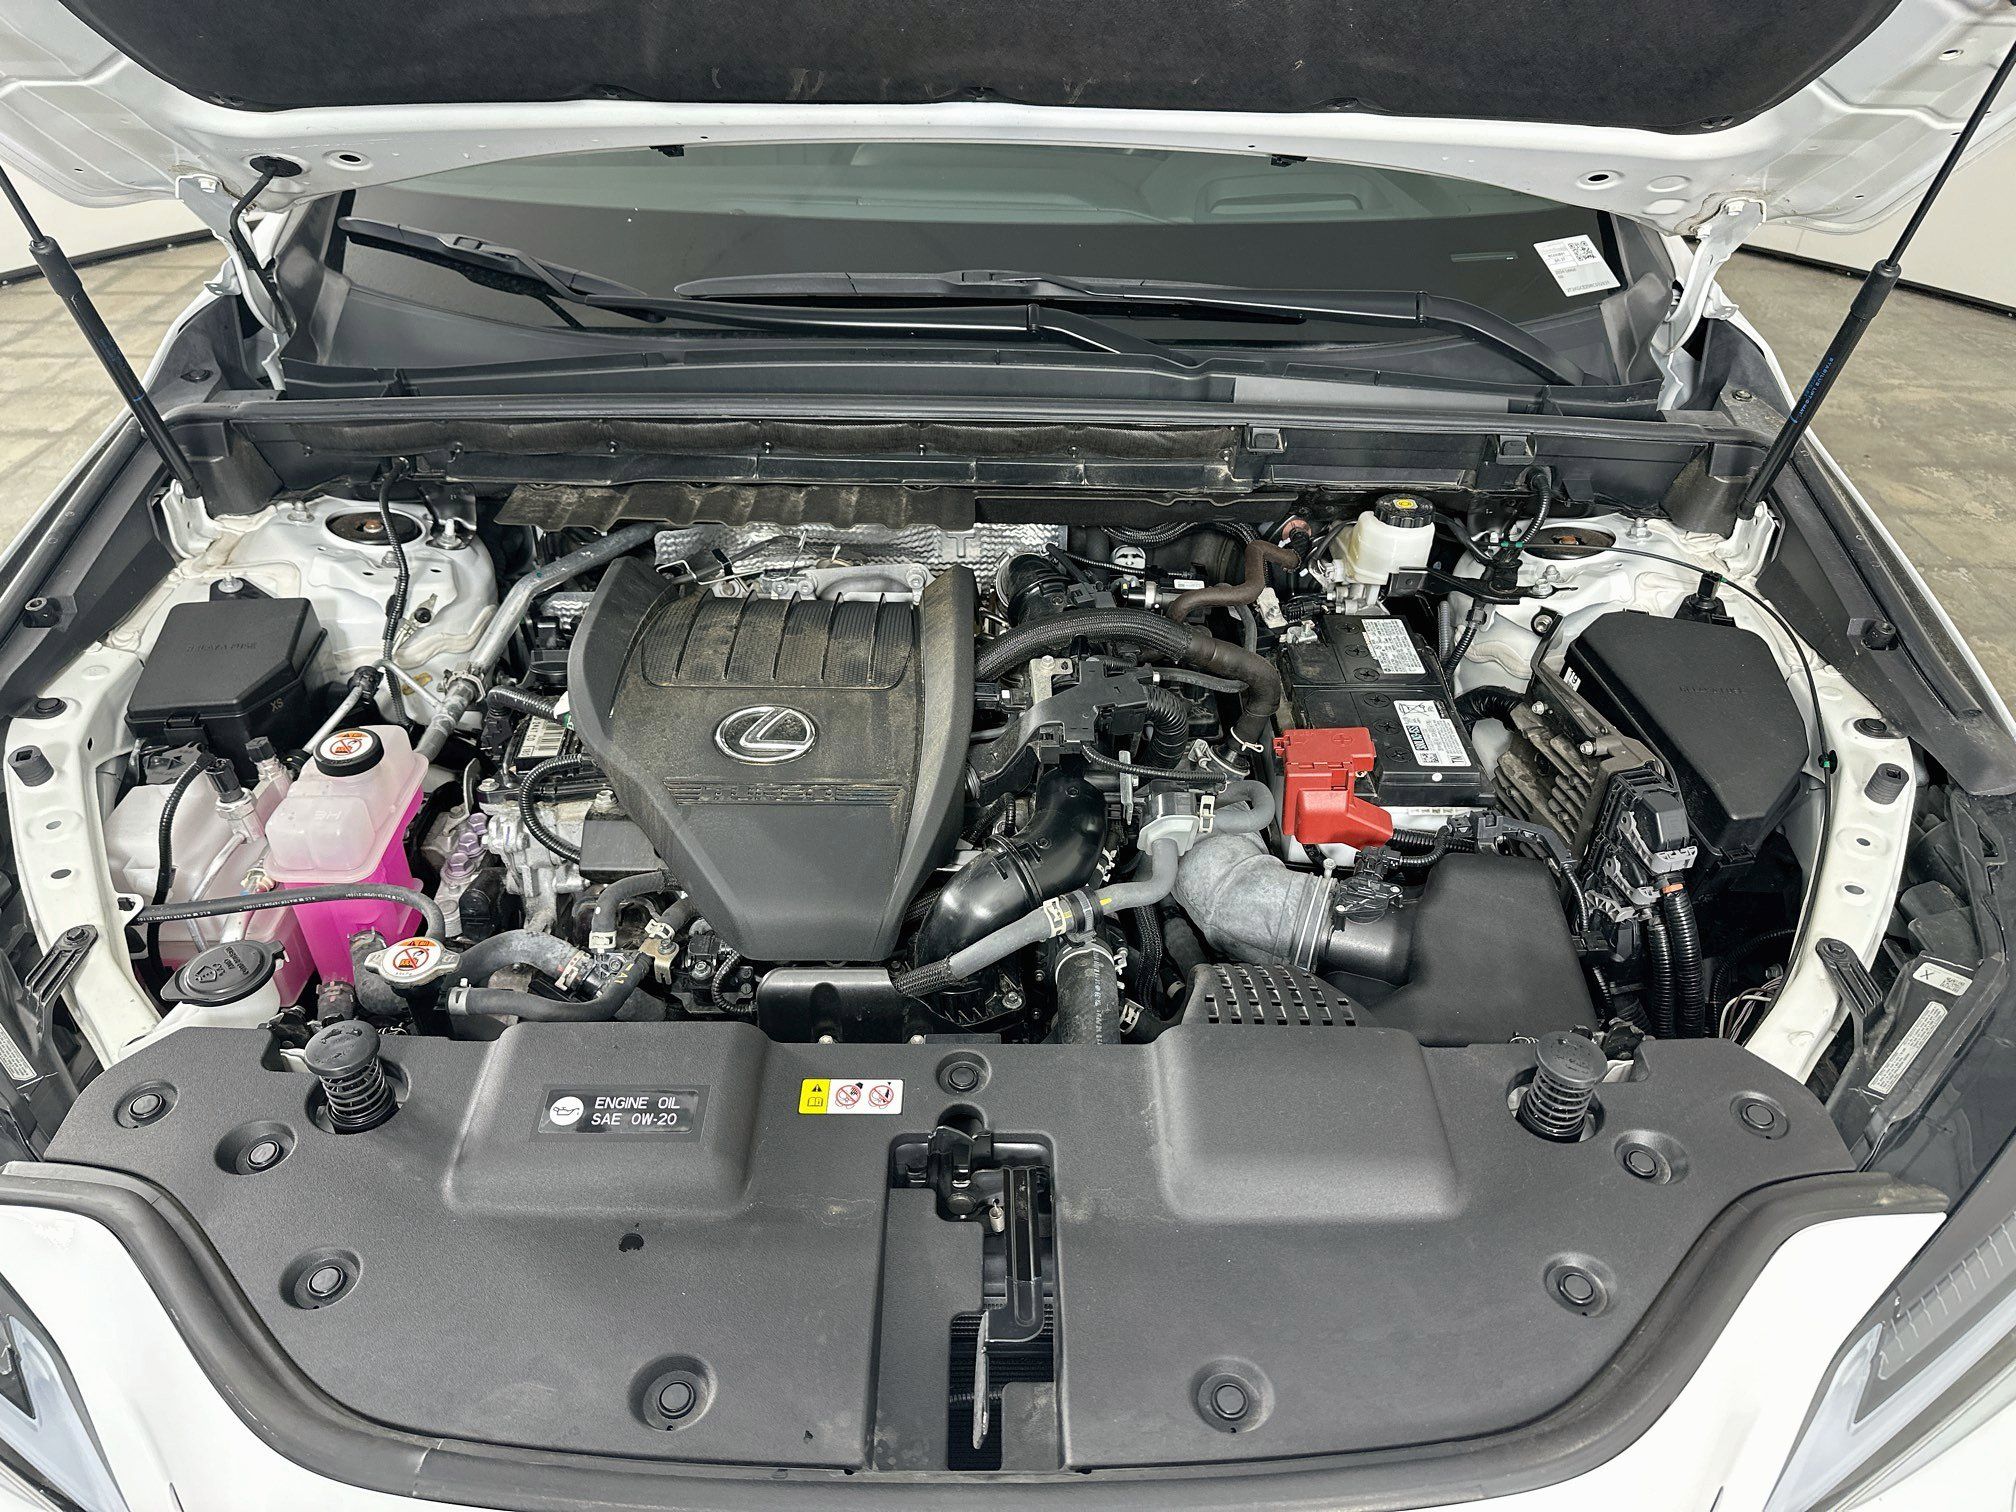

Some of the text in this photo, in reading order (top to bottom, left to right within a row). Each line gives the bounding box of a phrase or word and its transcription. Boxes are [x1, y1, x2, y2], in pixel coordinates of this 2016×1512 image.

[594, 1096, 681, 1109] ENGINE OIL
[591, 1112, 678, 1126] SAE 0W-20
